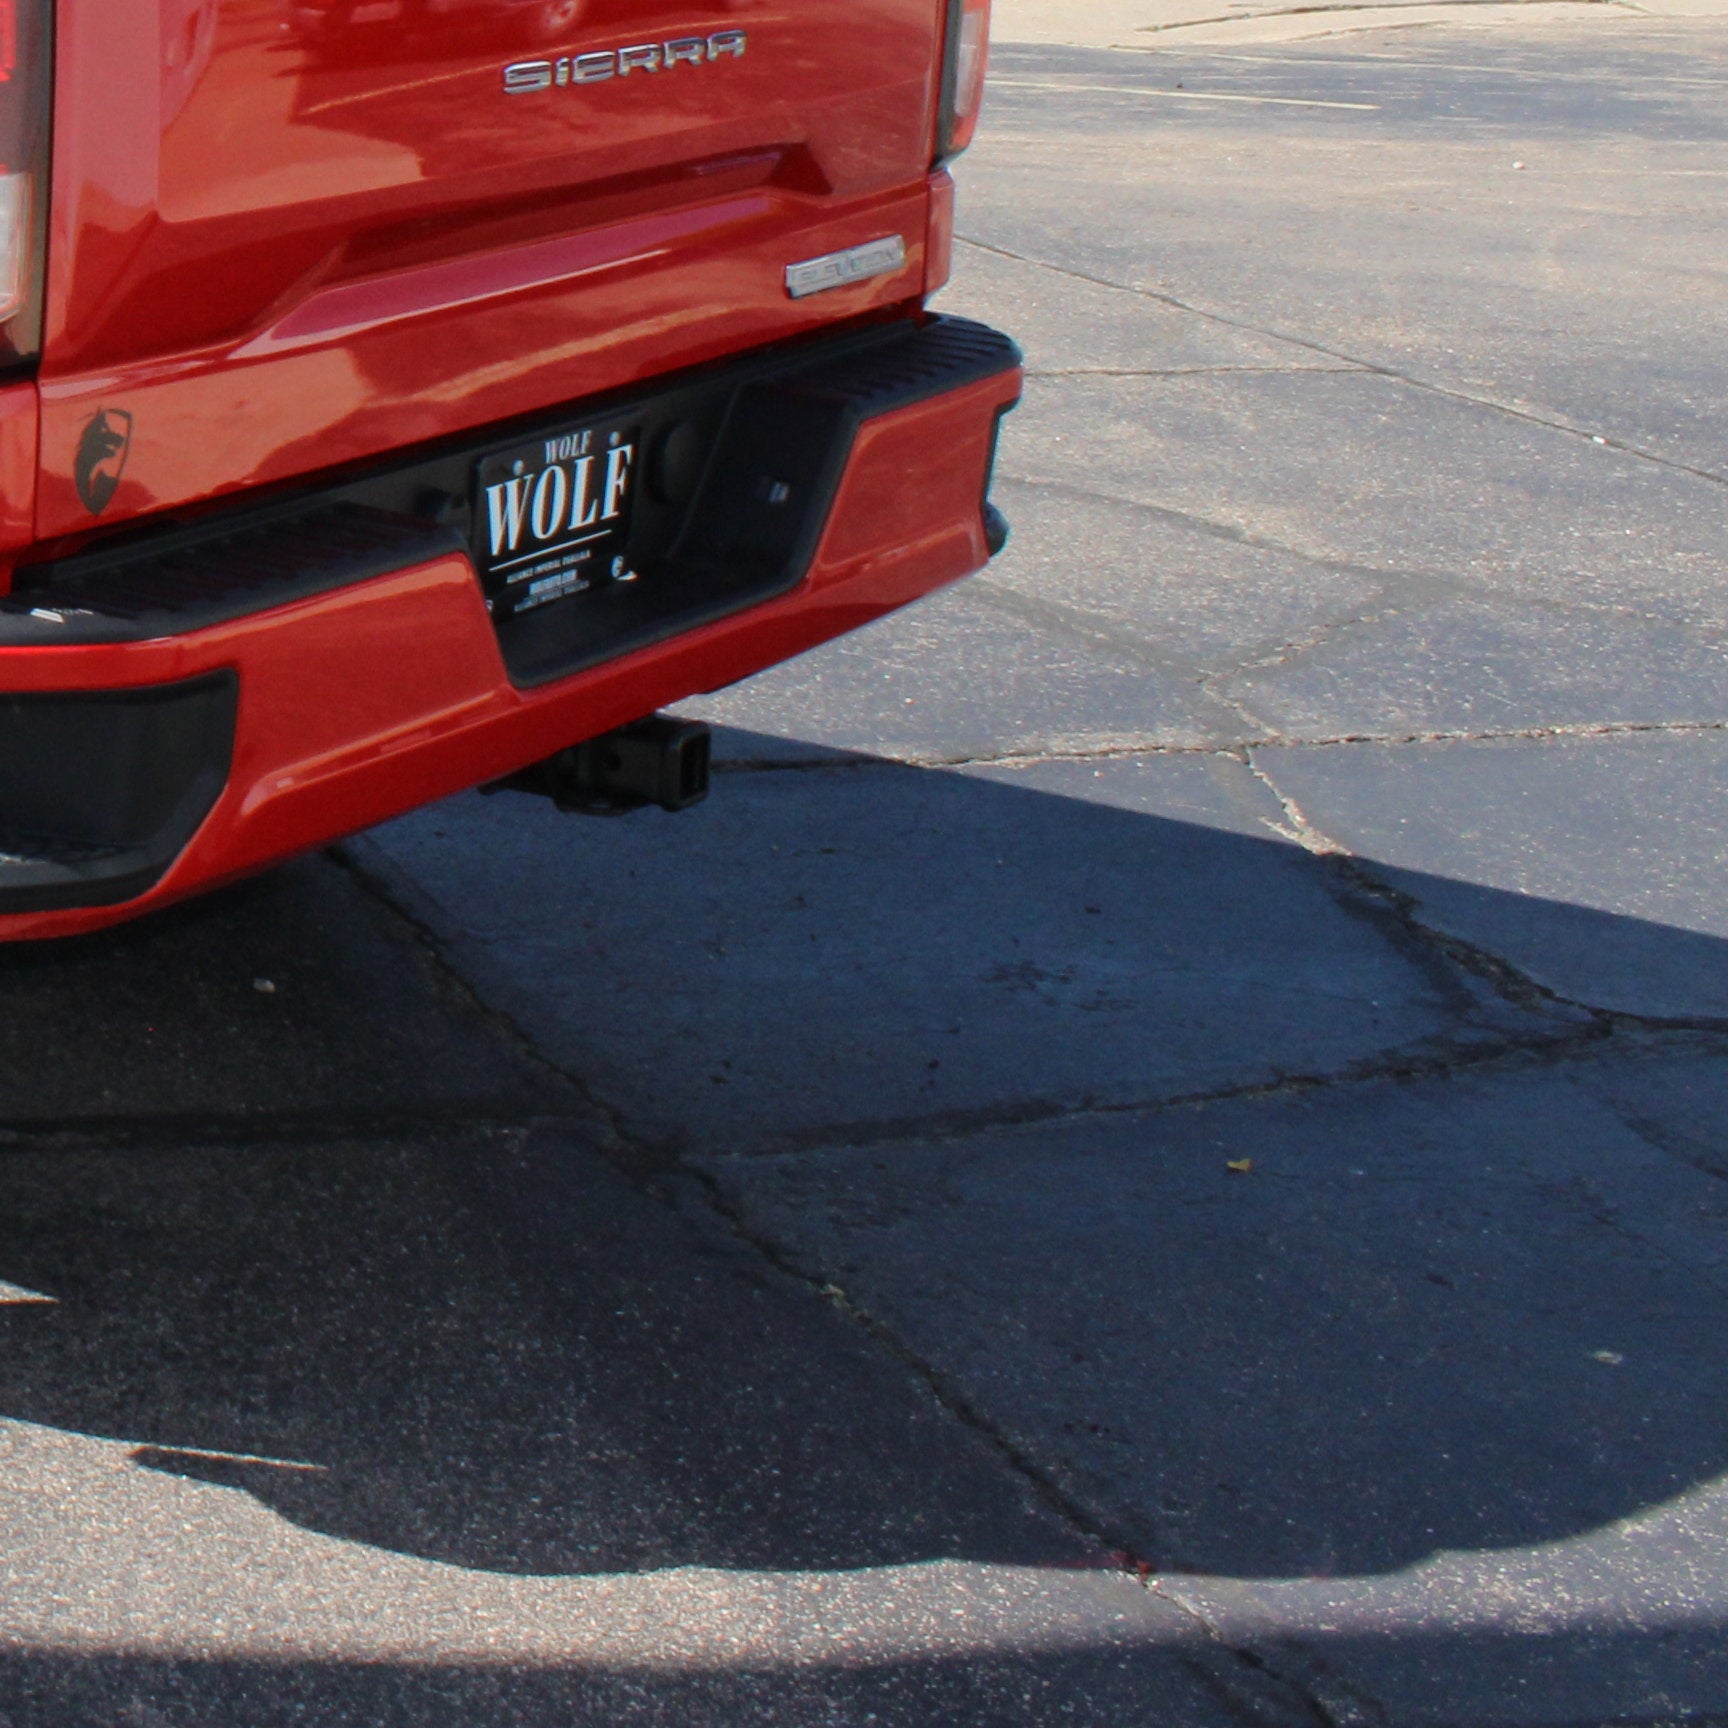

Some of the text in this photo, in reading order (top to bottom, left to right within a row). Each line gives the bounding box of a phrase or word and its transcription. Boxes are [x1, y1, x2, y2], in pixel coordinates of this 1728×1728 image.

[503, 29, 747, 95] SIERRA
[545, 430, 591, 464] WOLF
[486, 444, 632, 556] WOLF
